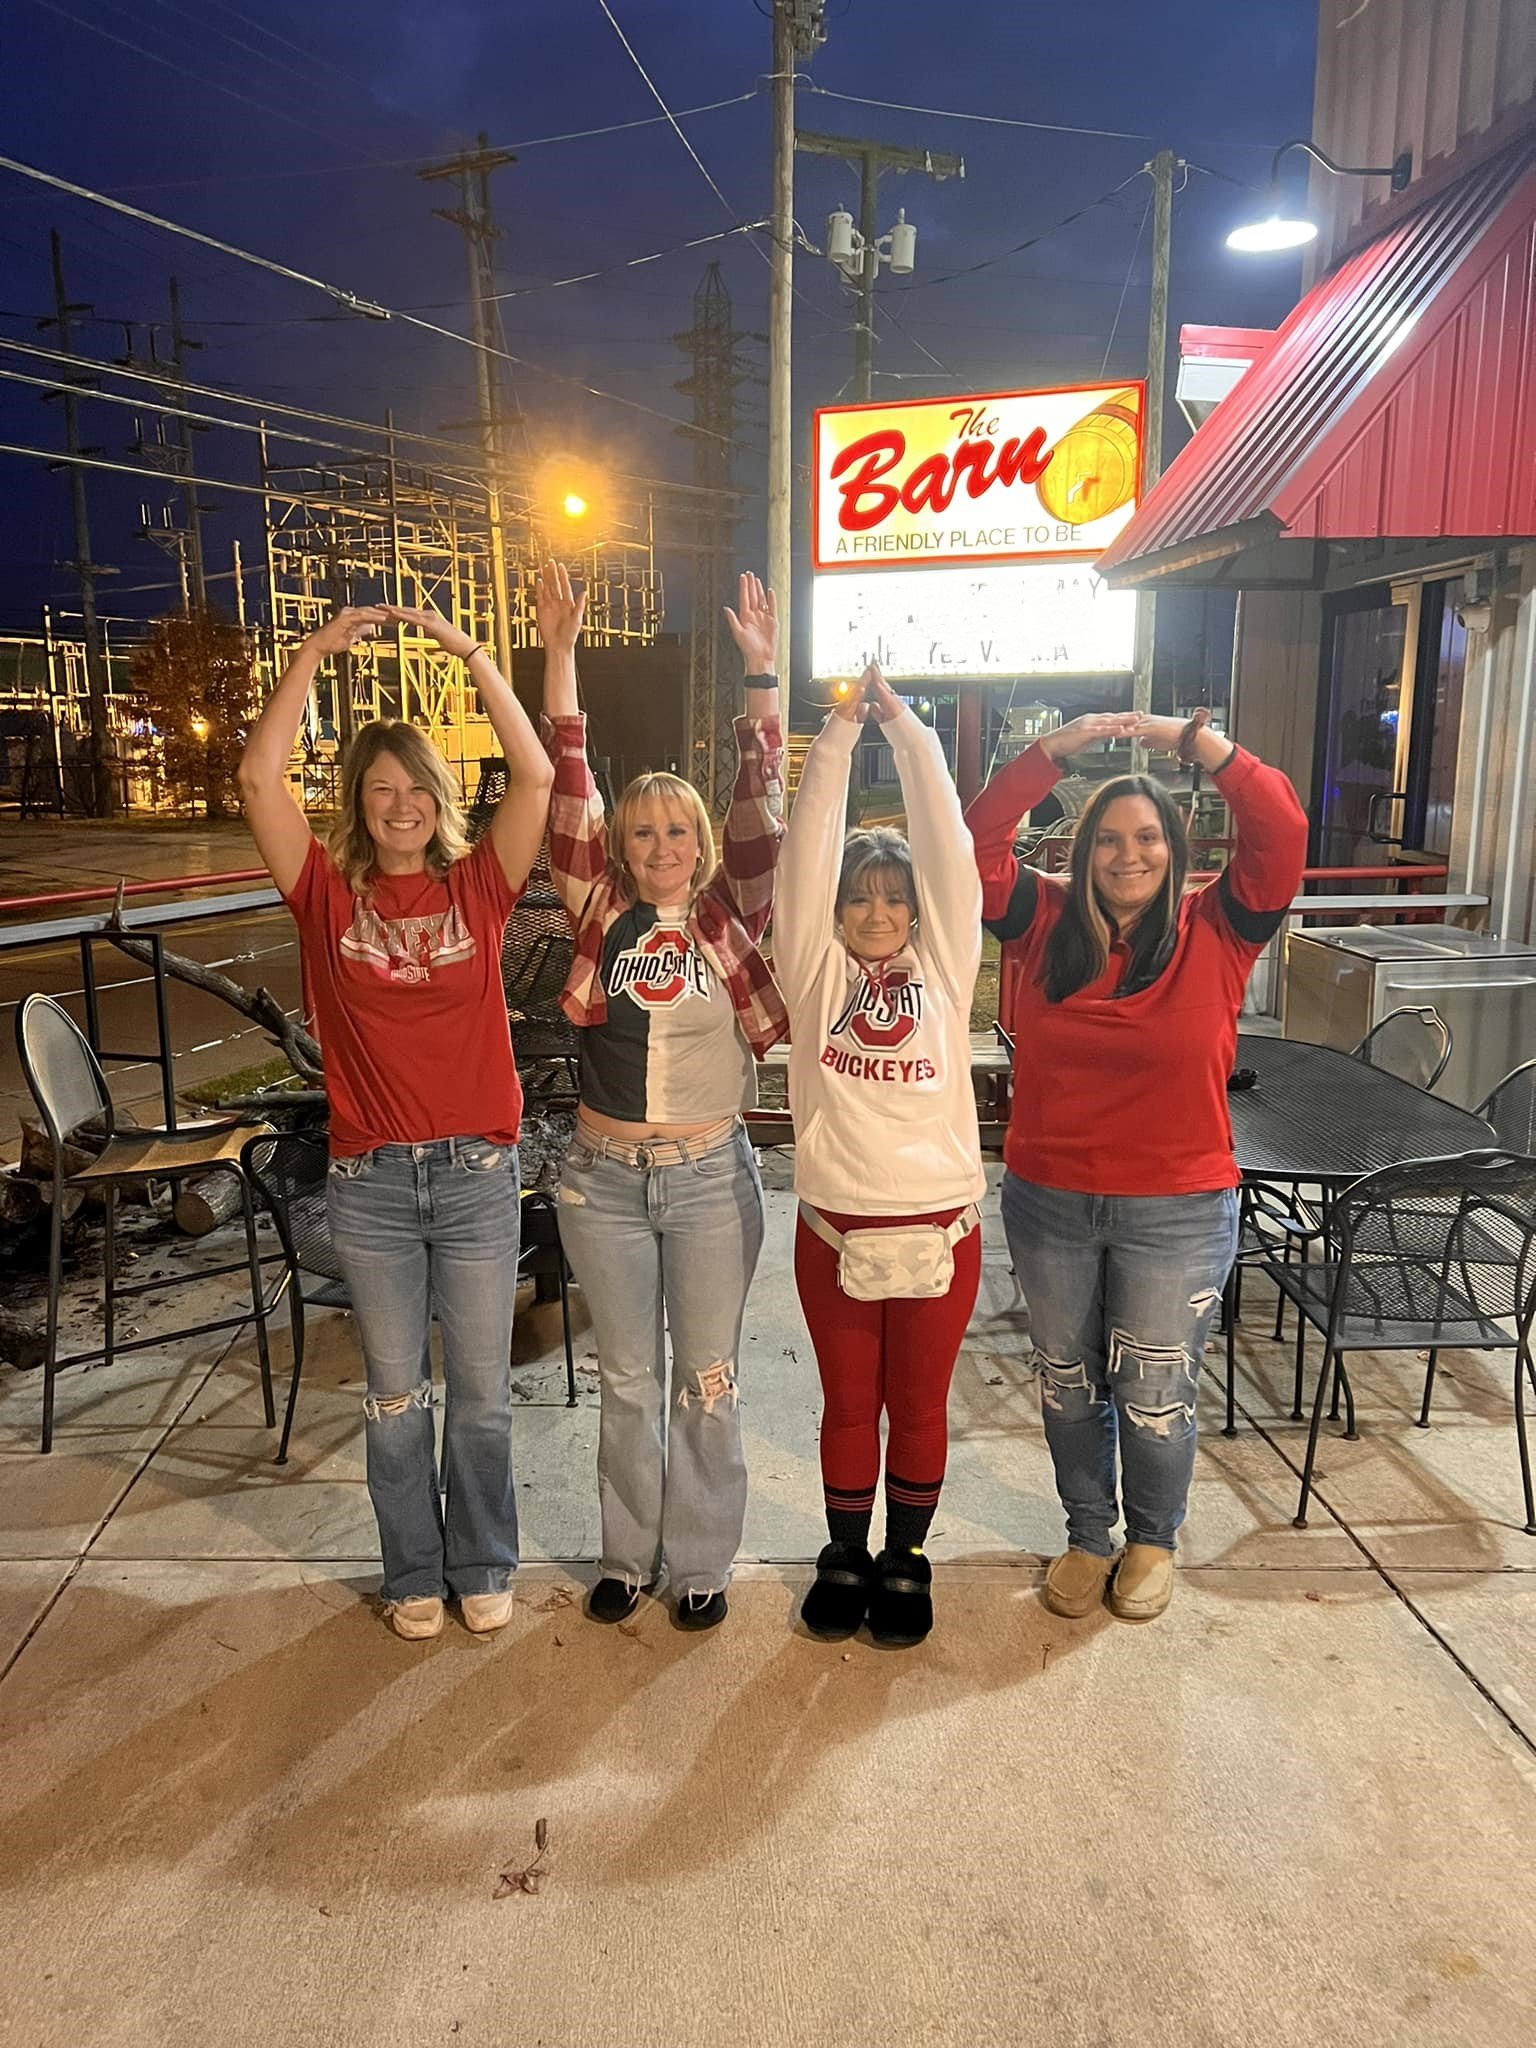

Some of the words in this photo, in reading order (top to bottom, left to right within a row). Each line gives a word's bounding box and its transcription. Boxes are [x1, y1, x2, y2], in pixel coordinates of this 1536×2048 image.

[949, 406, 1000, 439] The
[830, 426, 1055, 532] Barn
[835, 537, 848, 555] A
[853, 531, 945, 554] FRIENDLY
[950, 528, 1016, 548] PLACE
[1023, 526, 1051, 544] TO
[1055, 524, 1082, 542] BE
[611, 955, 661, 994] OHIO
[820, 1045, 936, 1083] BUCKEYES
